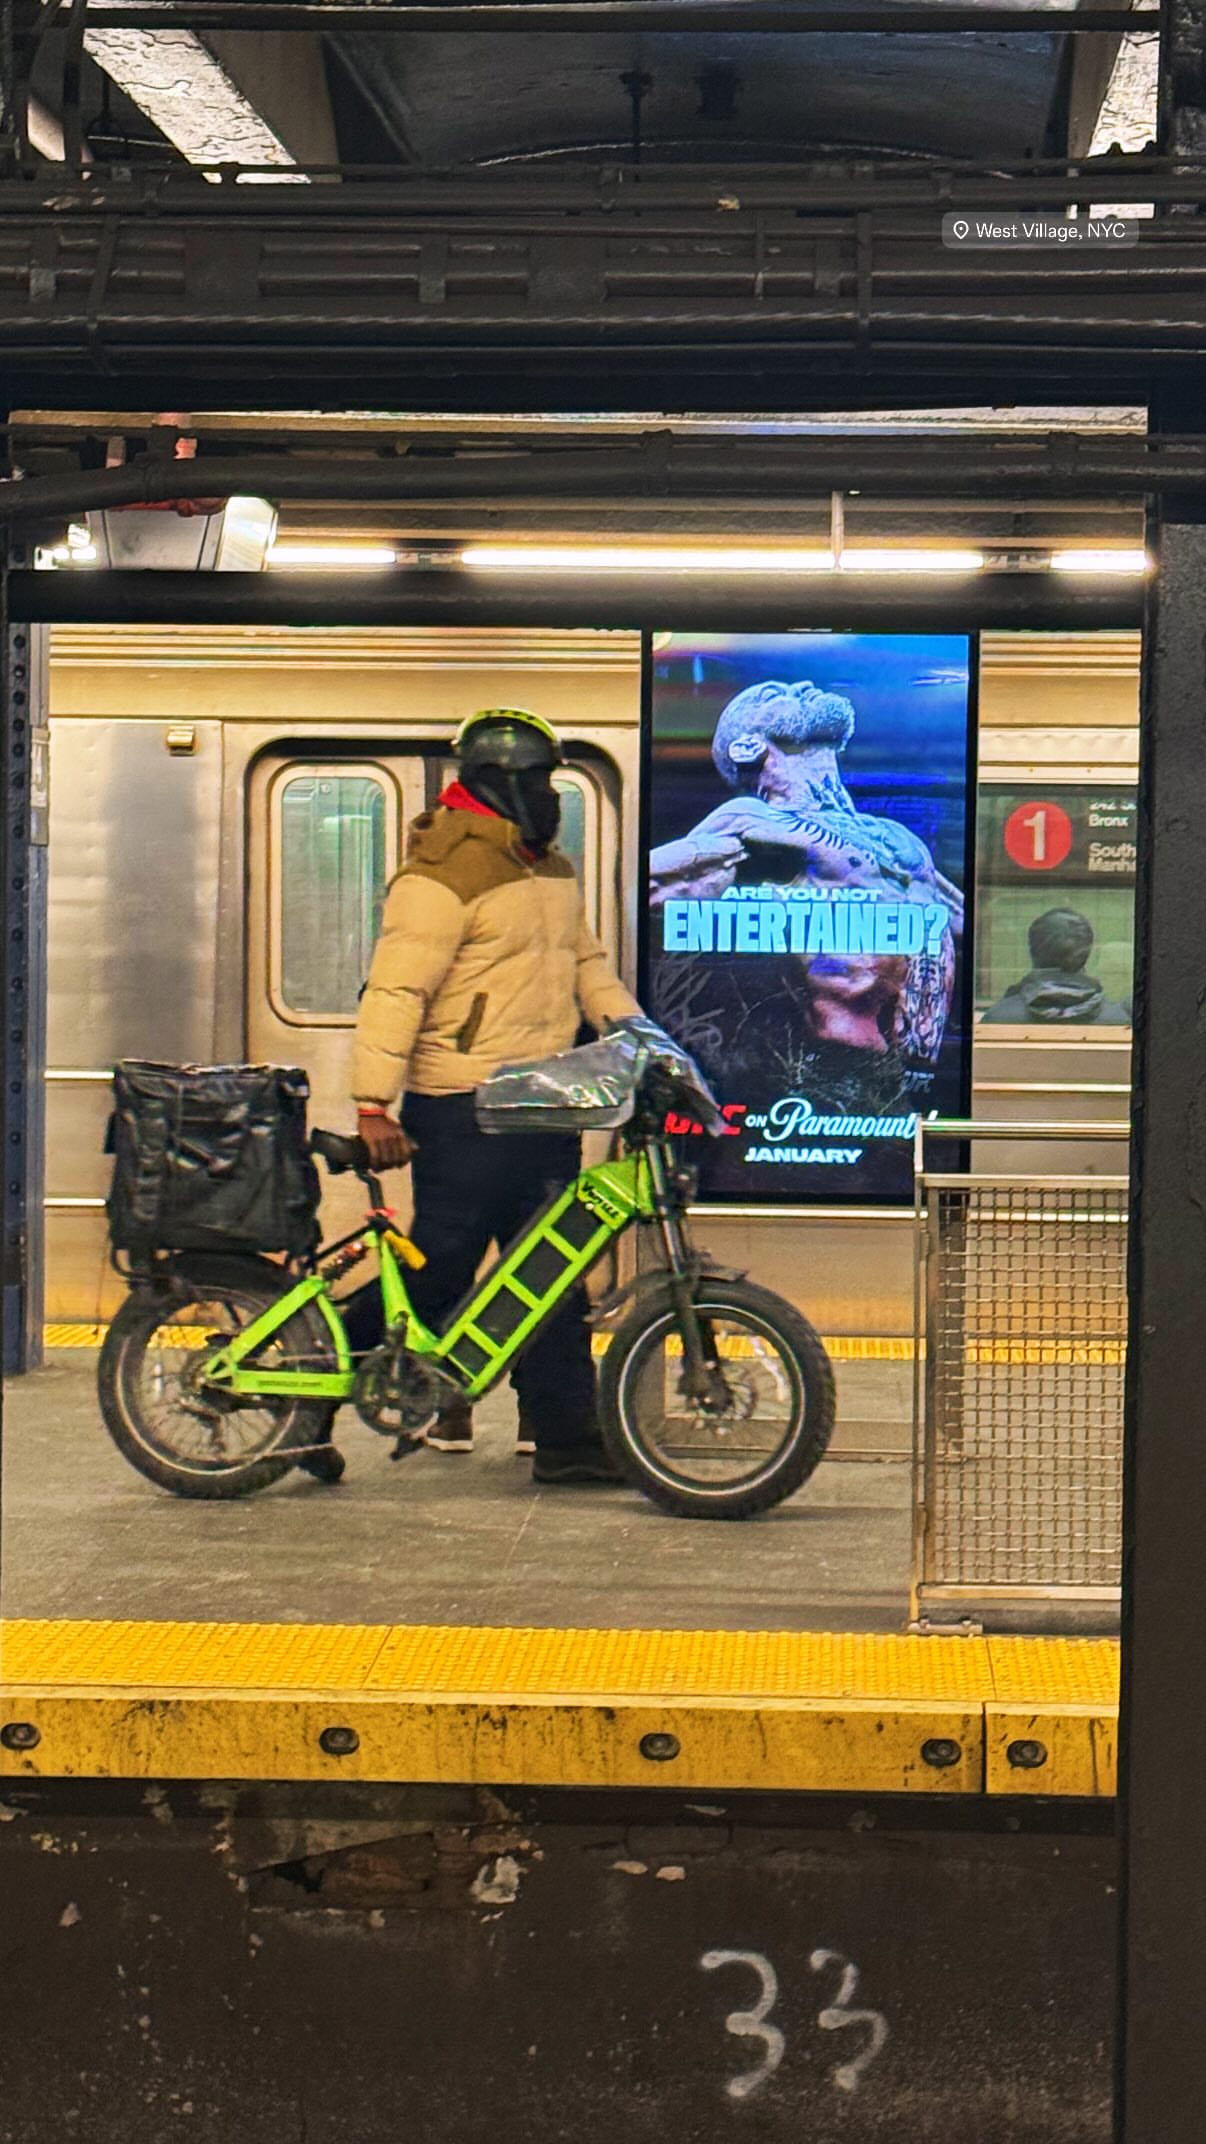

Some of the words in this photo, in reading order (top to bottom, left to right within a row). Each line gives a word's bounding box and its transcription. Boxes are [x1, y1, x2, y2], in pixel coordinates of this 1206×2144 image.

[1023, 810, 1046, 861] 1
[1088, 813, 1129, 828] Bronx
[1089, 843, 1136, 857] South
[720, 886, 772, 900] ARE
[777, 887, 828, 901] YOU
[830, 888, 882, 902] NOT
[664, 900, 949, 954] ENTERTAINED?
[664, 1104, 747, 1136] UC
[745, 1113, 767, 1128] ON
[763, 1097, 938, 1141] Paramount
[744, 1147, 863, 1164] JANUARY
[701, 1950, 888, 2097] 33
